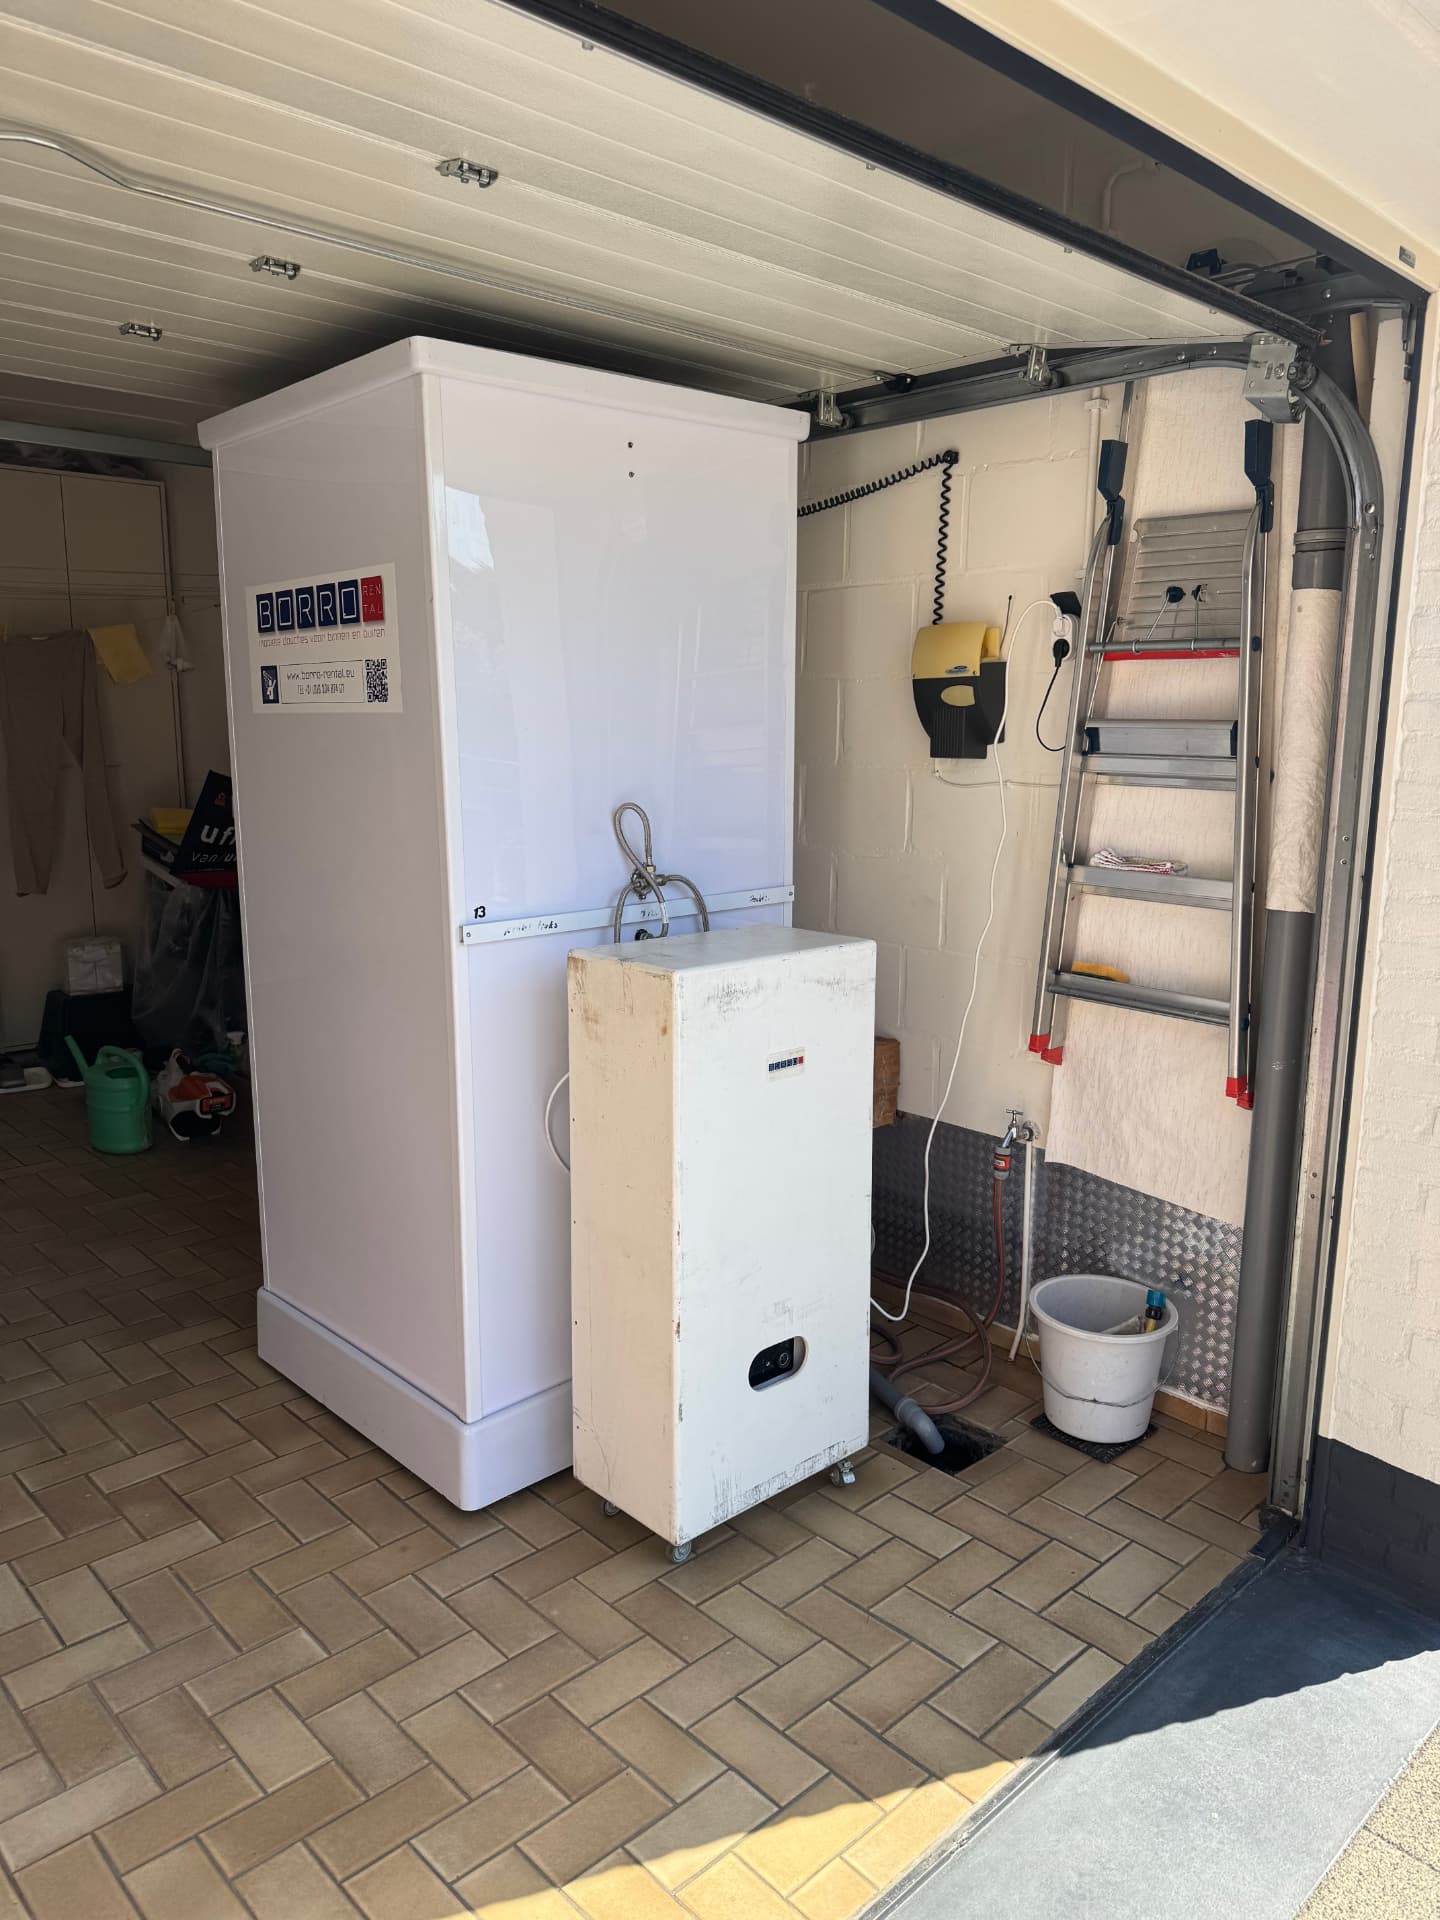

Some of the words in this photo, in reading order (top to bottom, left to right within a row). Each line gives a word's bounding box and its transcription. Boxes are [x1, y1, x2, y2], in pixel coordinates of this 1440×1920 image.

[362, 583, 382, 596] REN
[259, 588, 357, 628] BORRO
[362, 603, 383, 615] TAL
[473, 905, 486, 919] 13
